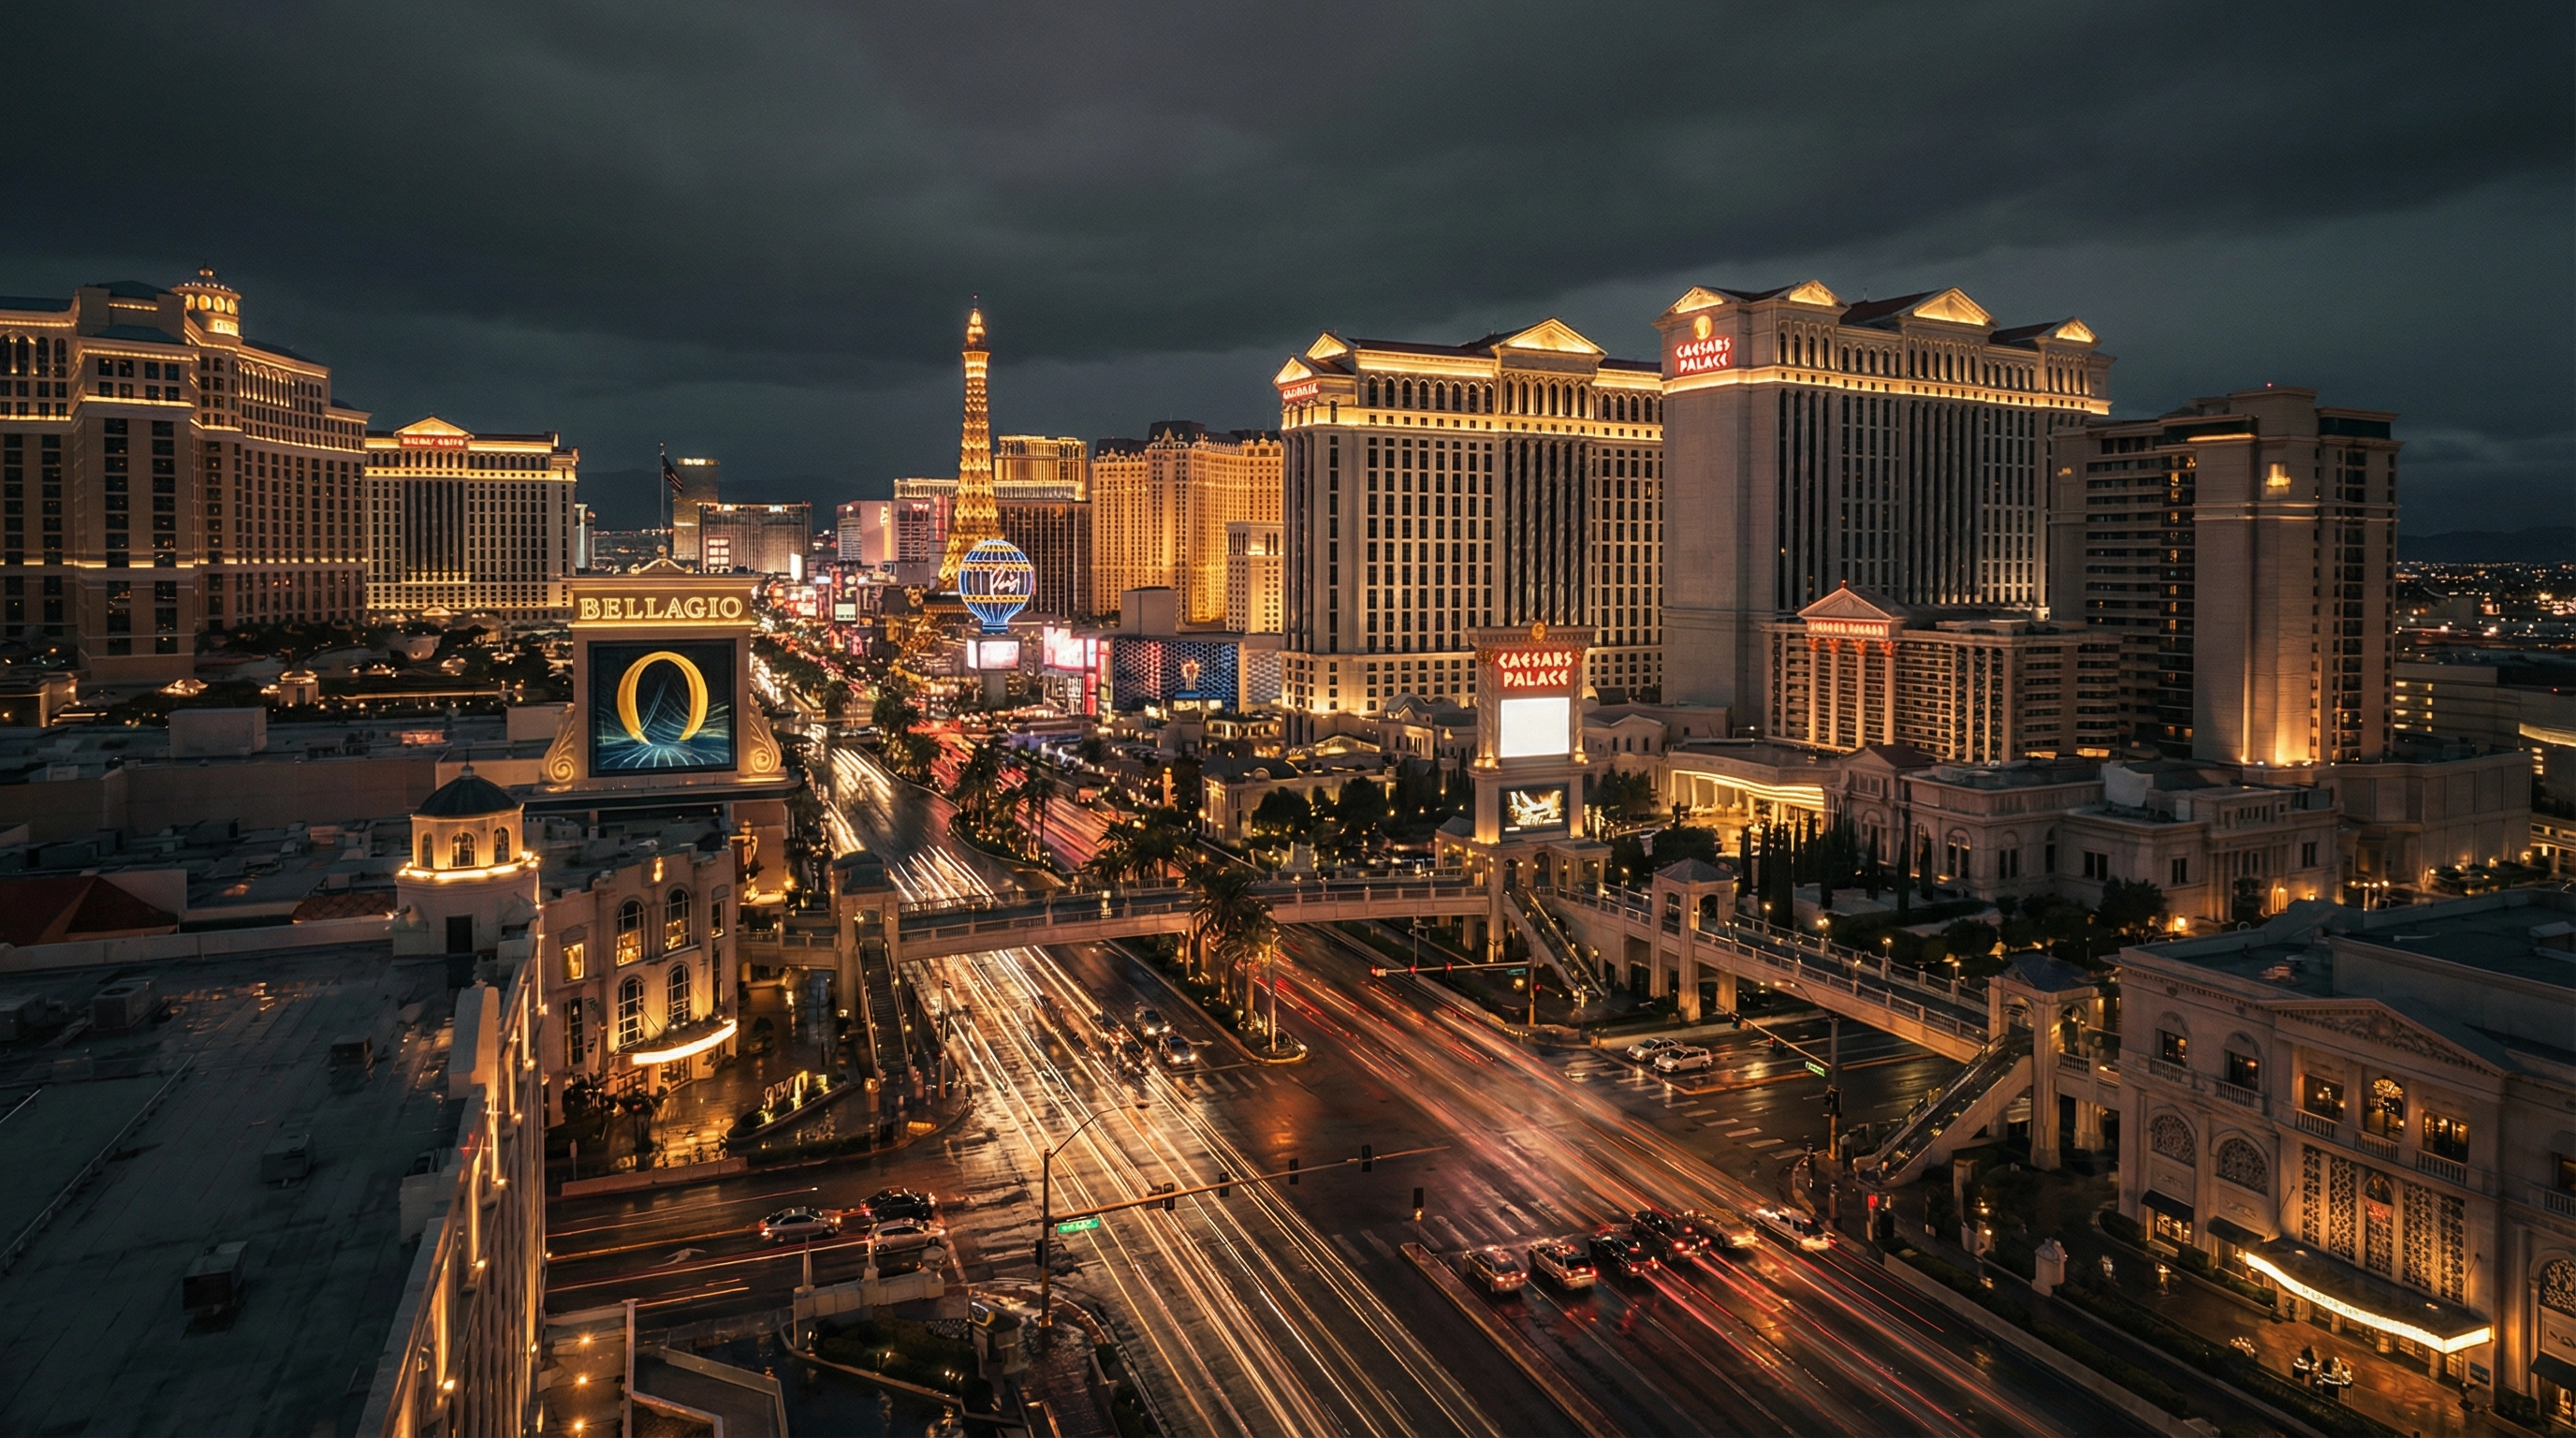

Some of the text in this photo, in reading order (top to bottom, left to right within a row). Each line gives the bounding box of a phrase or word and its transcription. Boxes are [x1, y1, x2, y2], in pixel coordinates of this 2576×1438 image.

[578, 596, 743, 620] BELLAGIO
[1498, 651, 1573, 669] CAESARS
[1503, 669, 1569, 688] PALACE
